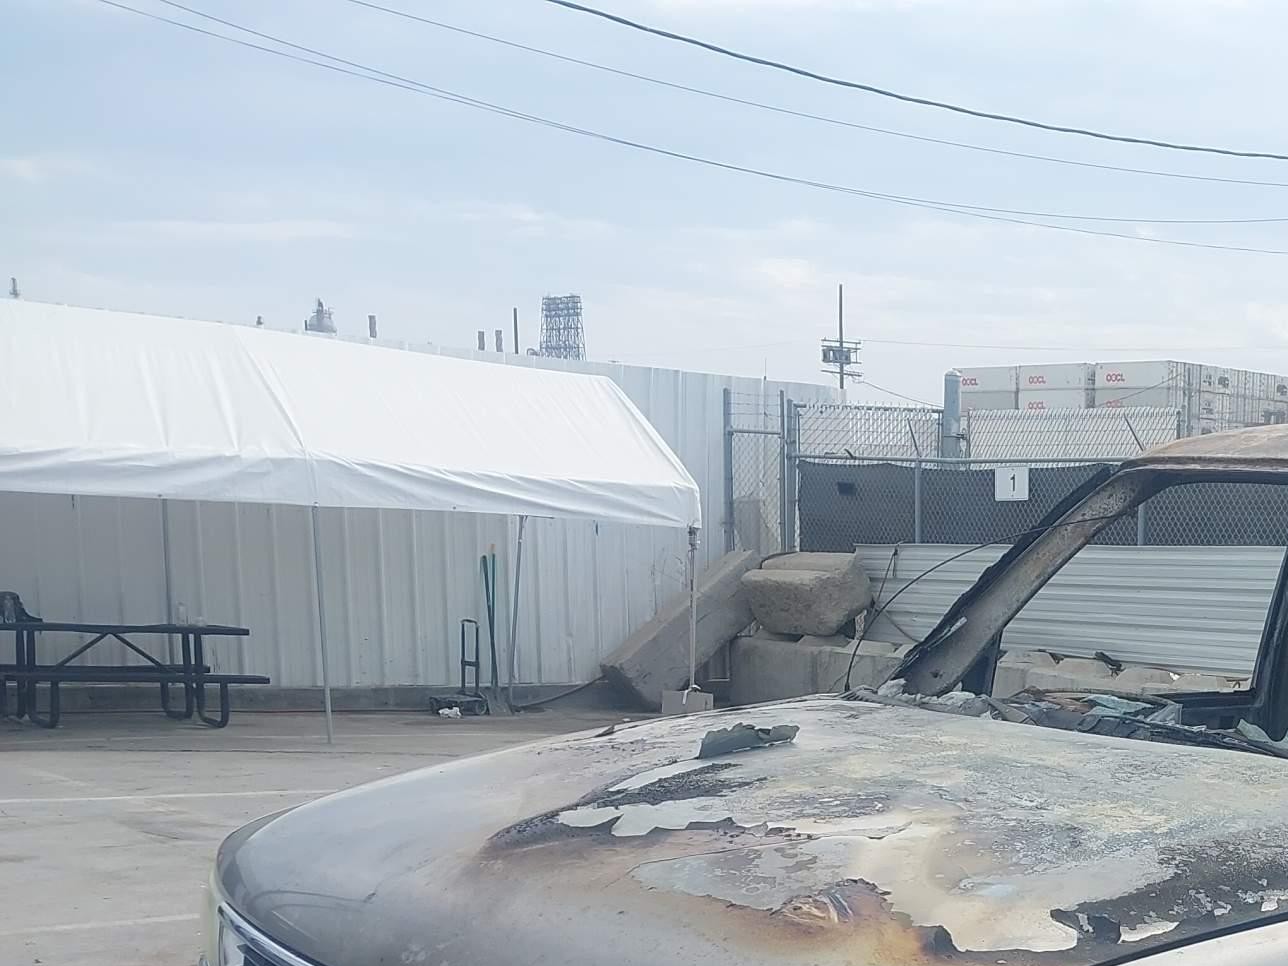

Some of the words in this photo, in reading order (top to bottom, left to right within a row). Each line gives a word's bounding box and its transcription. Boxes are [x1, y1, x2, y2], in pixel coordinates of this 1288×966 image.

[1028, 376, 1046, 384] OOCL
[1106, 373, 1125, 382] OOCL
[962, 378, 978, 386] OOCL
[1010, 473, 1016, 492] 1
